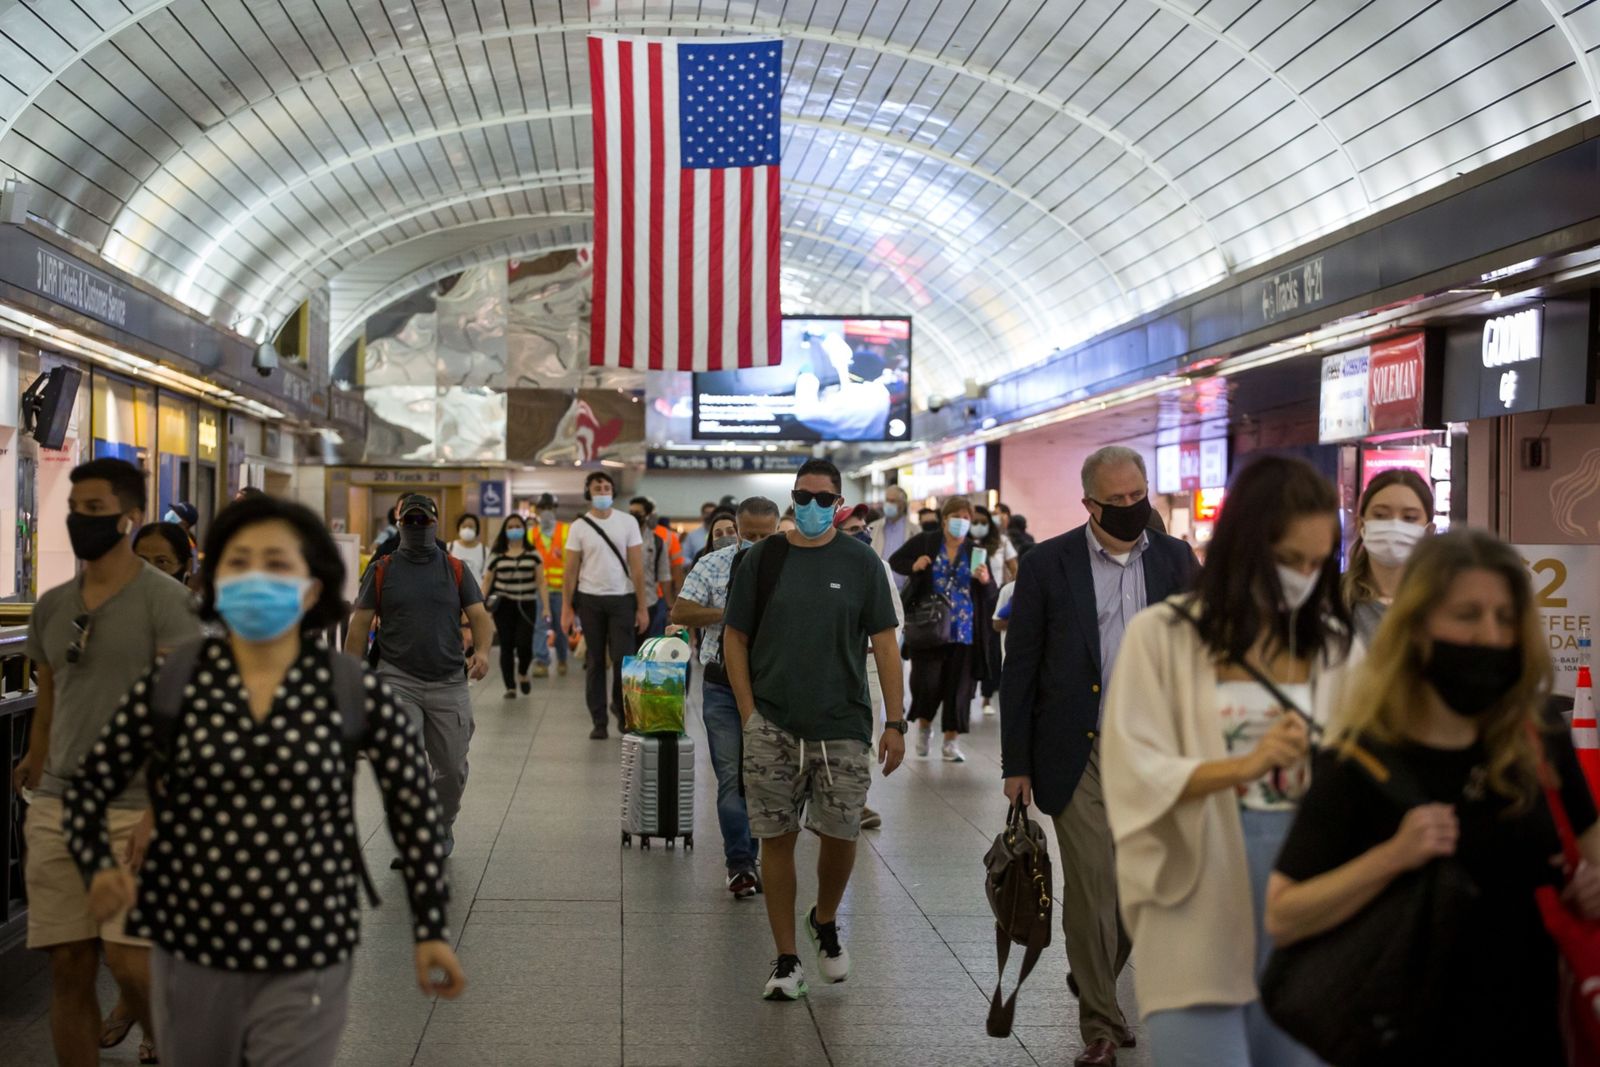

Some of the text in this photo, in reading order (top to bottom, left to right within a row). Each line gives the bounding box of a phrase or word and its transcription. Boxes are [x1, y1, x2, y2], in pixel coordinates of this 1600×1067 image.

[58, 261, 78, 306] Tickets
[83, 274, 108, 317] Customer
[108, 285, 126, 327] Service
[1274, 275, 1299, 314] Tracks
[1371, 359, 1418, 405] SOLEMAN
[394, 471, 422, 482] Track
[667, 455, 708, 469] Tracks
[1527, 558, 1568, 608] 2
[1549, 634, 1579, 651] DA
